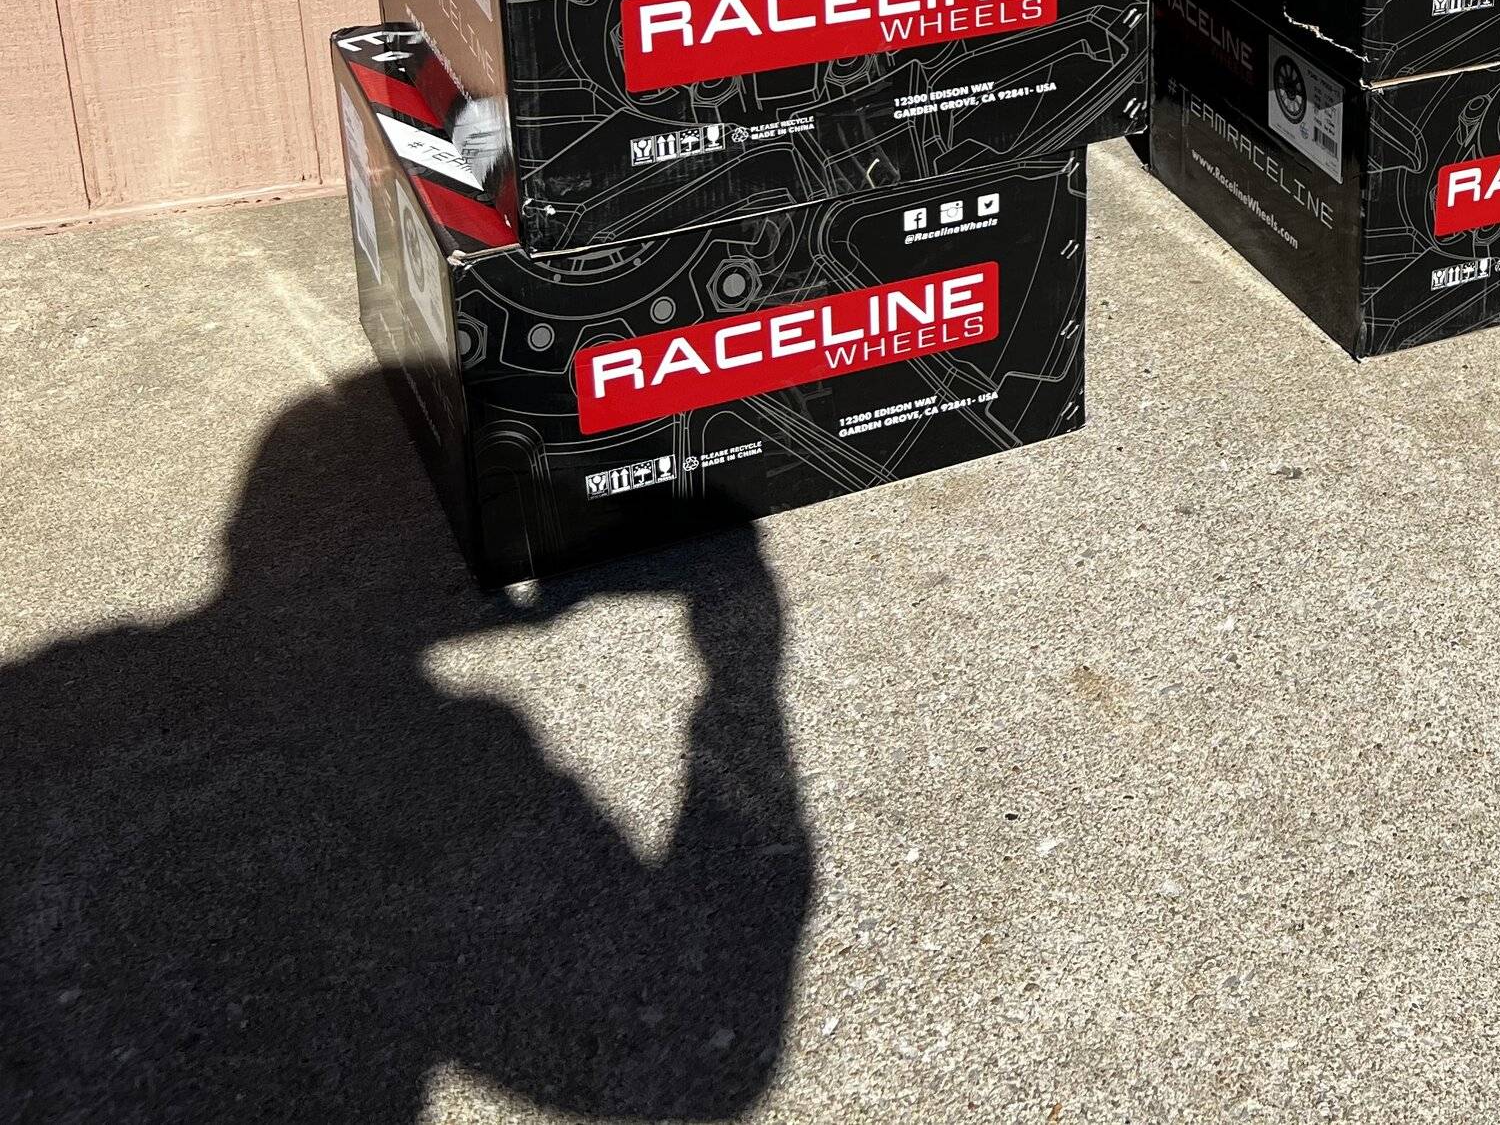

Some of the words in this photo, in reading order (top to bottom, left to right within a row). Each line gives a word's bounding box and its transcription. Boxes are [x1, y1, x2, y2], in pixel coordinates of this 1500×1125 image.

[893, 93, 928, 107] 12300
[929, 86, 969, 101] EDISON
[970, 81, 995, 93] WAY
[893, 103, 938, 119] GARDEN
[939, 97, 980, 111] GROVE,
[981, 93, 996, 103] CA
[1035, 82, 1057, 94] USA
[750, 122, 780, 133] PLEASE
[781, 115, 815, 127] RECYCLE
[750, 131, 777, 140] MADE
[777, 128, 787, 136] IN
[787, 123, 815, 134] CHINA
[1167, 78, 1335, 230] #TEAMRACELINE
[1191, 149, 1299, 250] www.RacelineWheels.com
[904, 217, 999, 245] @RacelineWheels
[592, 273, 985, 399] RACELINE
[824, 315, 985, 371] WHEELS
[838, 412, 873, 427] 12300
[874, 401, 913, 418] EDISON
[914, 395, 938, 408] WAY
[838, 420, 883, 438] GARDEN
[883, 410, 924, 426] GROVE,
[924, 407, 939, 416] CA
[978, 391, 999, 403] USA
[700, 450, 729, 461] PLEASE
[730, 440, 763, 455] RECYCLE
[701, 457, 726, 468] MADE
[727, 455, 736, 463] IN
[737, 447, 763, 460] CHINA
